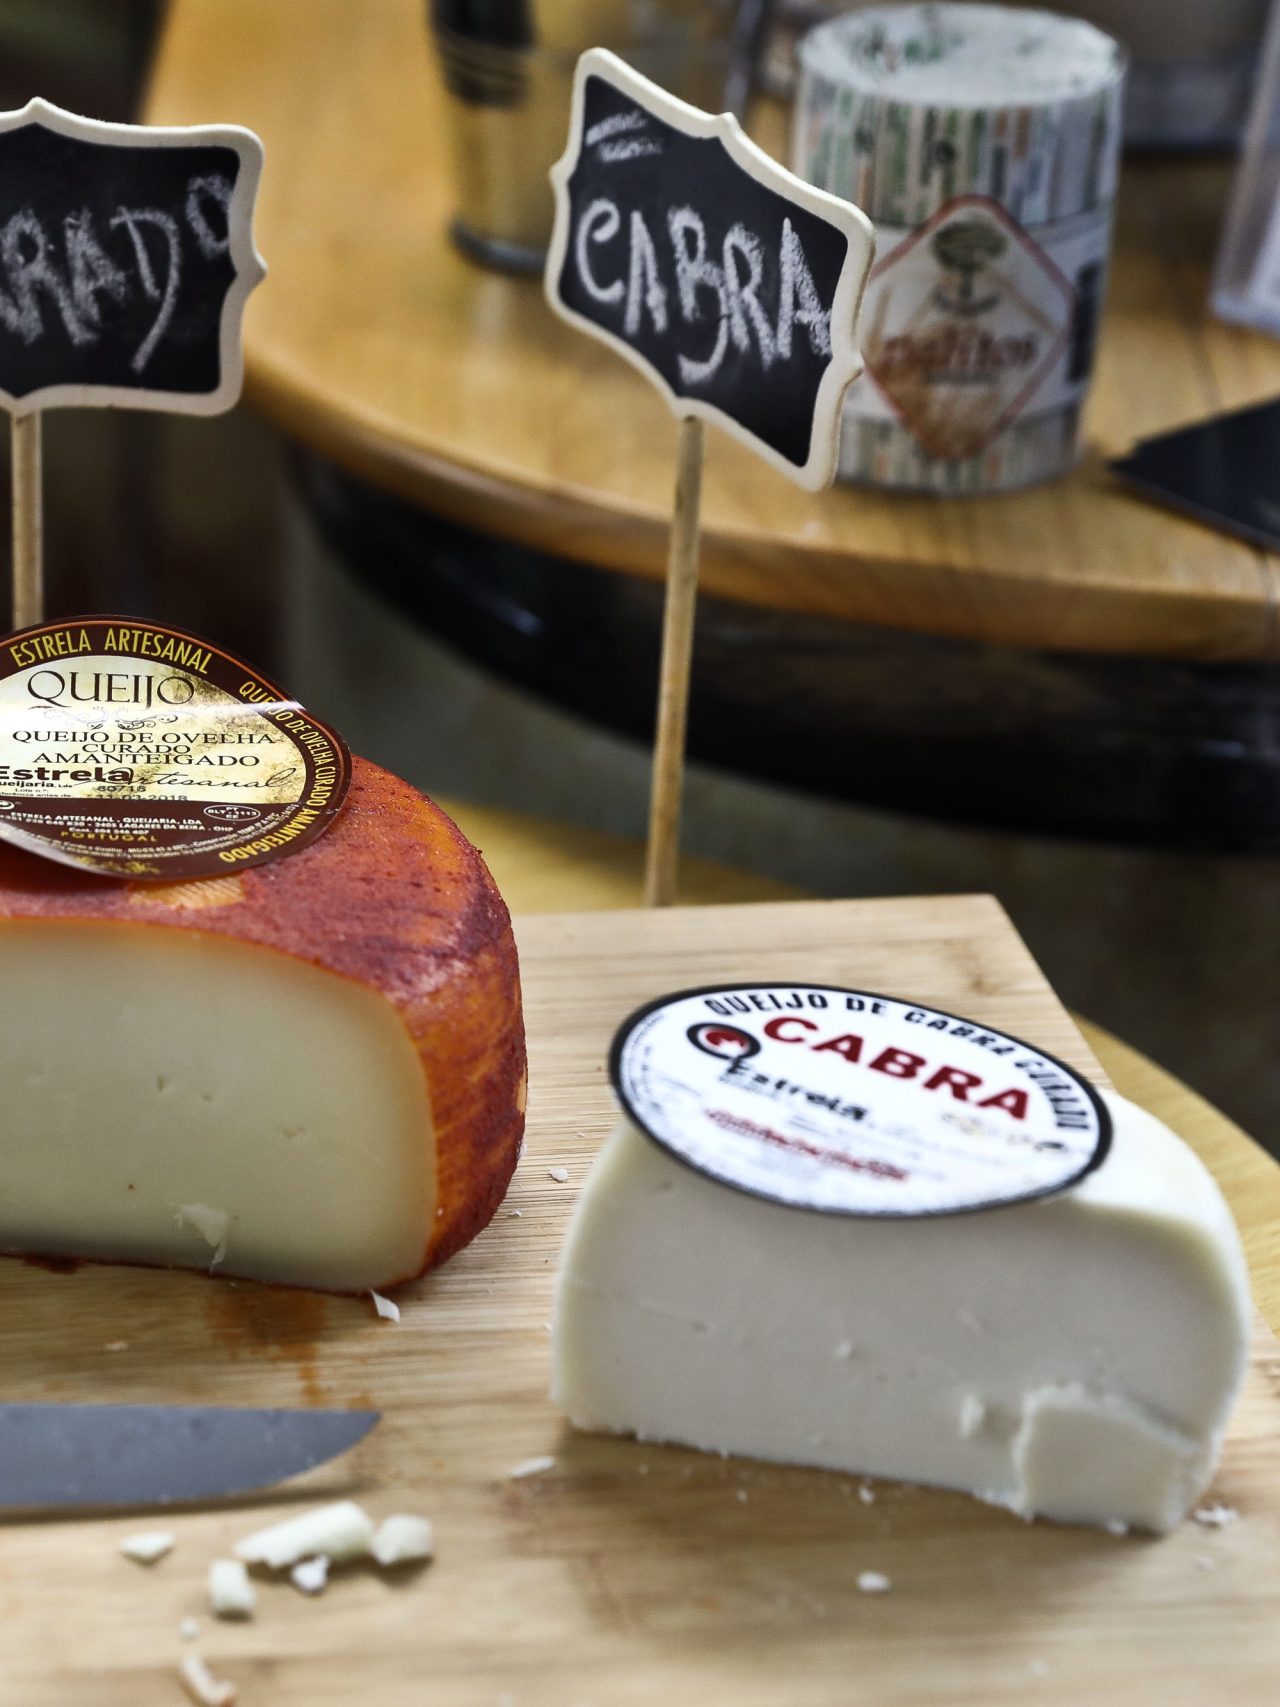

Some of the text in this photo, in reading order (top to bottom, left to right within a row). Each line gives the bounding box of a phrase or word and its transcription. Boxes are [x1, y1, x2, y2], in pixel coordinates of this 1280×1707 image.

[576, 198, 834, 384] CABRA
[9, 628, 213, 675] ESTRELA ARTESANAL
[27, 670, 195, 709] QUEIJO
[239, 681, 294, 721] QUEJO
[12, 730, 276, 745] QUEIJO DE OVELHA
[285, 717, 308, 733] DE
[32, 752, 260, 766] AMANTEIGADO
[81, 743, 191, 753] CURADO
[301, 731, 335, 766] OVELHA
[306, 766, 336, 806] CURADO
[61, 831, 158, 842] PORTUGAL
[219, 806, 320, 864] AMANTEIGADO
[704, 994, 828, 1017] QUEIJO
[846, 997, 887, 1015] DE
[763, 1016, 1031, 1121] CABRA
